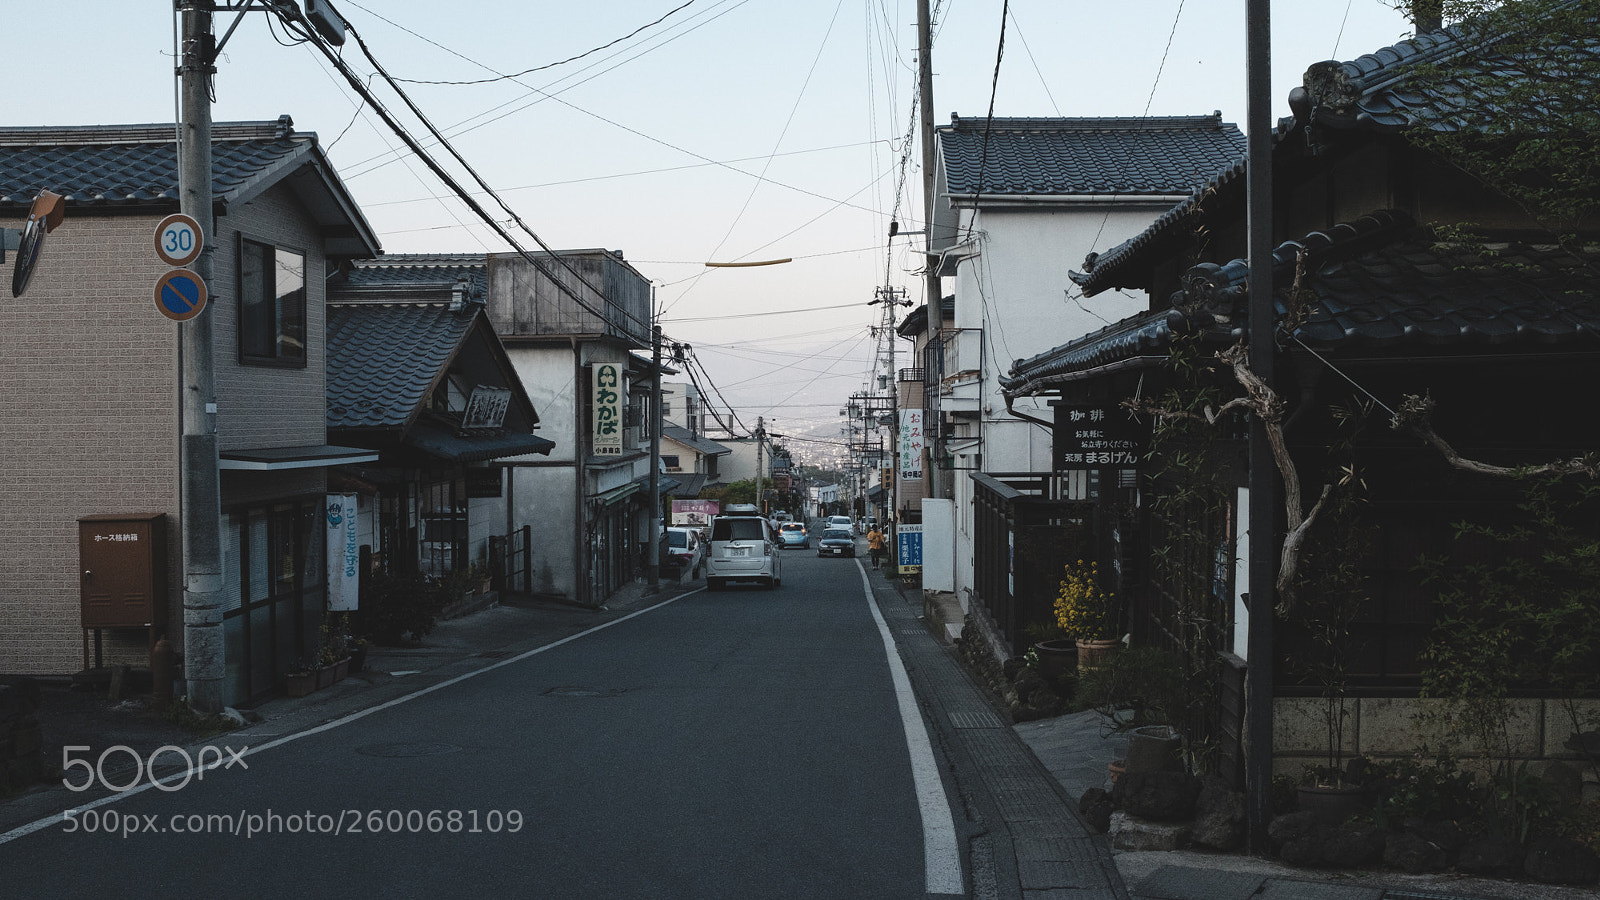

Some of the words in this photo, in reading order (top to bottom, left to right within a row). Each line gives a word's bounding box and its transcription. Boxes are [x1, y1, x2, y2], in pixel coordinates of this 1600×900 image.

[166, 229, 191, 252] 30
[596, 388, 619, 435] わかば
[910, 413, 921, 467] おみやげ
[1075, 430, 1104, 438] お気軽に
[1081, 440, 1138, 449] お立寄りください
[1064, 453, 1083, 462] 茶房
[1085, 451, 1138, 464] まるげん
[94, 533, 138, 542] ホース格納箱
